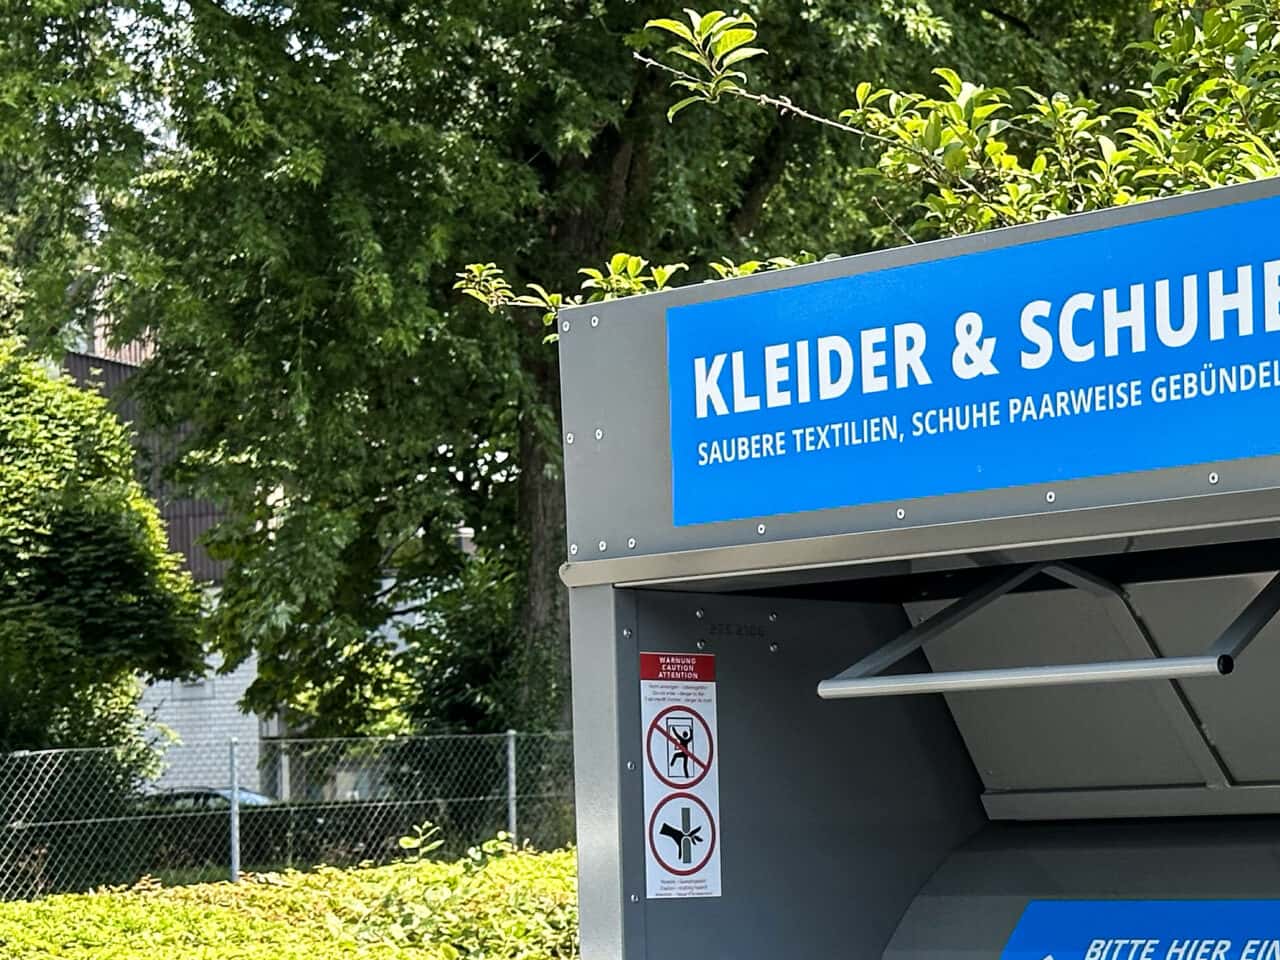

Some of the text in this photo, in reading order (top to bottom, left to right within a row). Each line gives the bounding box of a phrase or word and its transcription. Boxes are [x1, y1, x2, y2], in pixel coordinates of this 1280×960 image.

[694, 321, 933, 418] KLEIDER
[951, 311, 999, 380] &
[697, 430, 787, 467] SAUBERE
[791, 414, 905, 453] TEXTILIEN,
[911, 400, 1001, 437] SCHUHE
[1008, 379, 1143, 424] PAARWEISE
[658, 656, 697, 665] WARNUNG
[661, 664, 695, 672] CAUTION
[657, 671, 699, 680] ATTENTION
